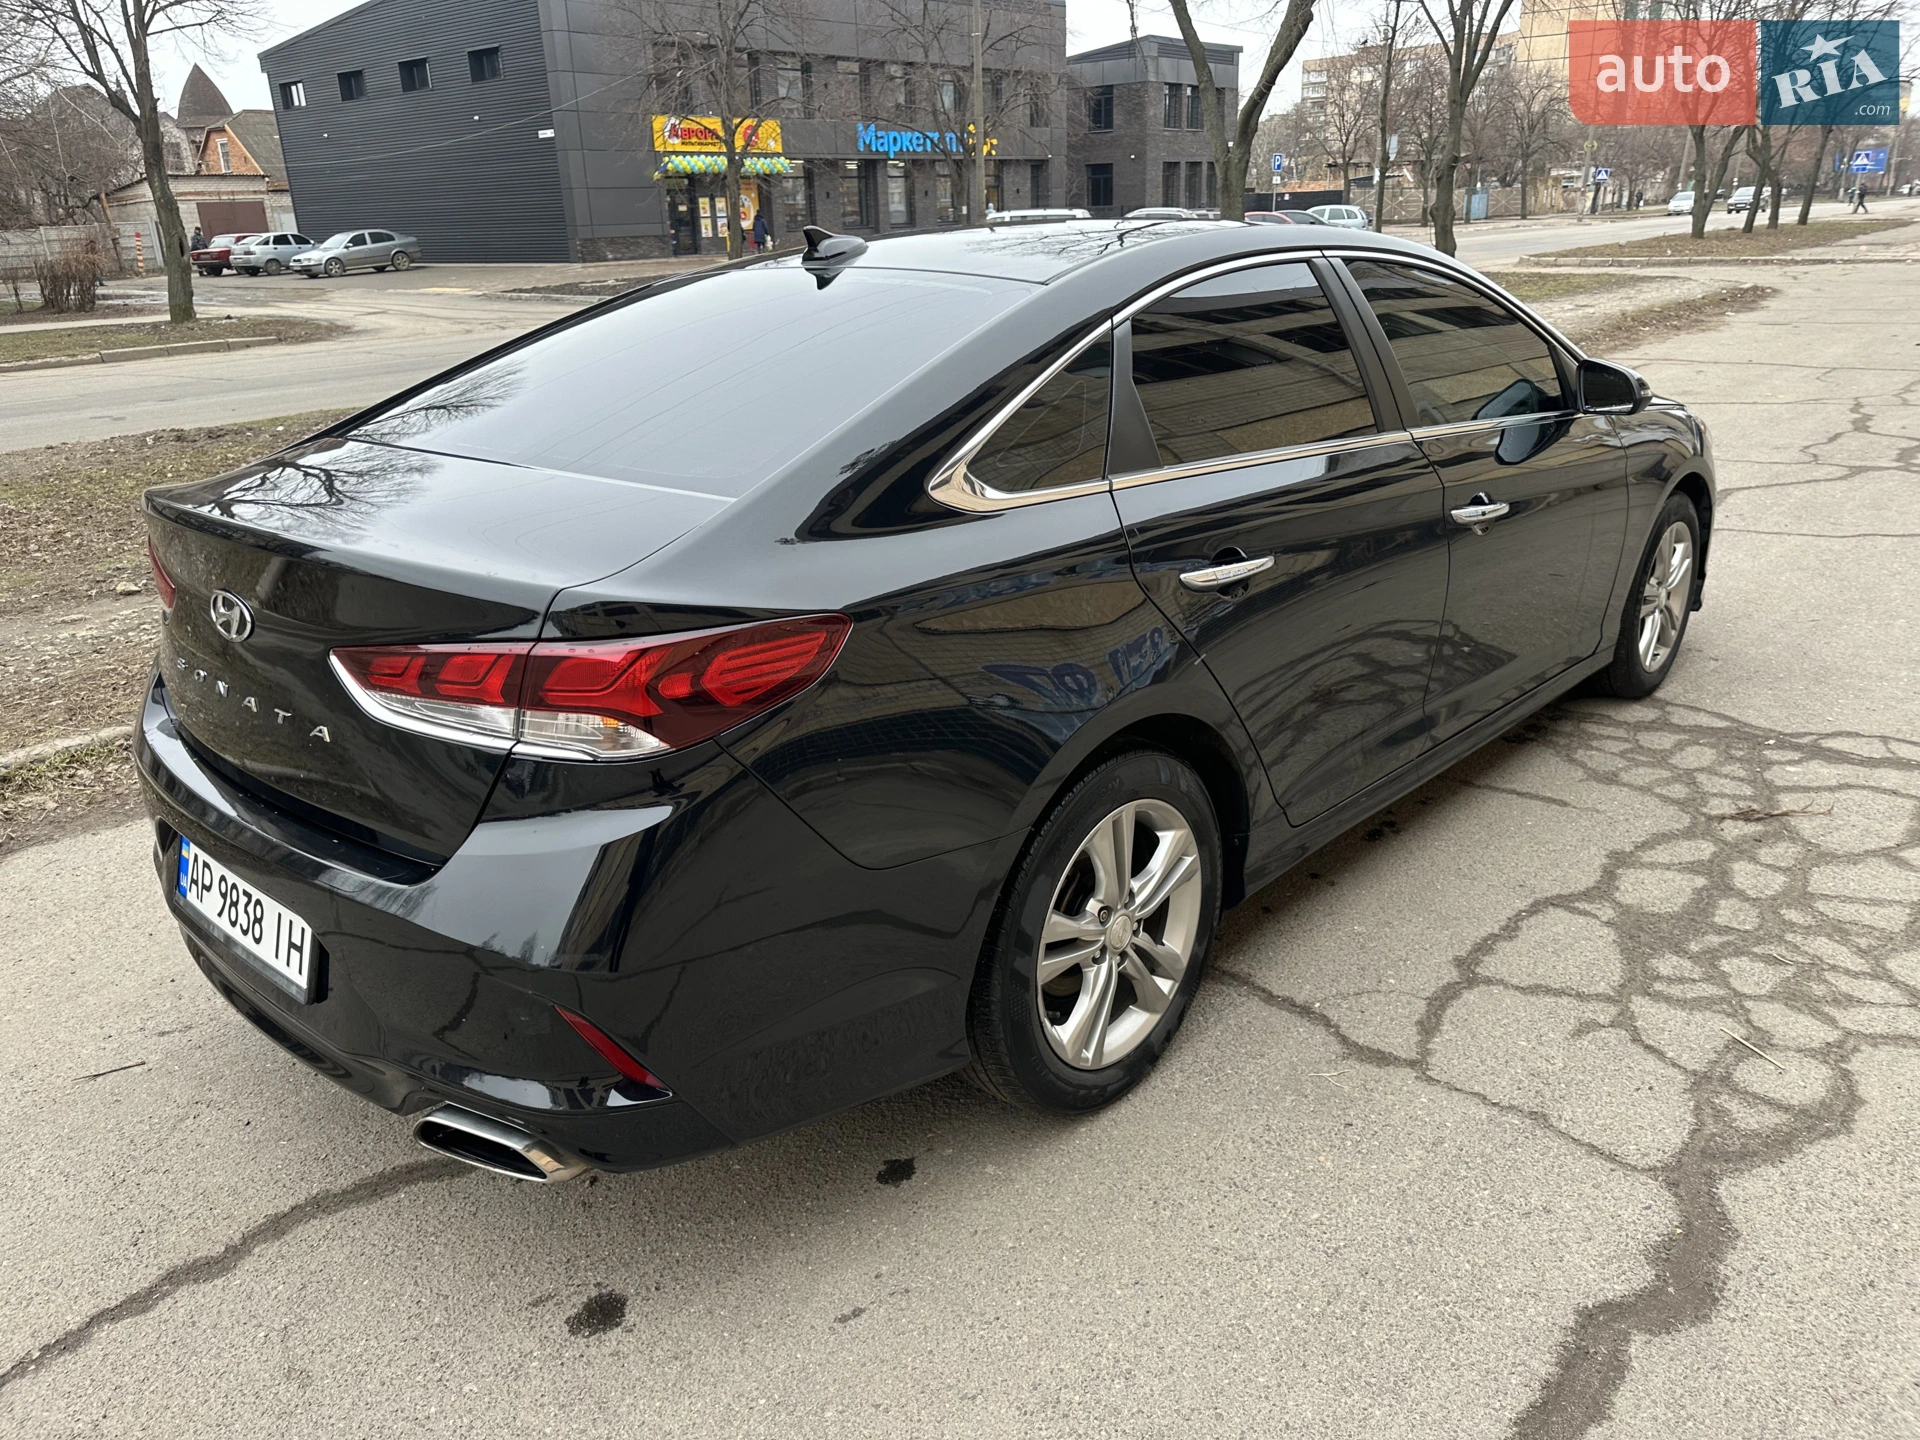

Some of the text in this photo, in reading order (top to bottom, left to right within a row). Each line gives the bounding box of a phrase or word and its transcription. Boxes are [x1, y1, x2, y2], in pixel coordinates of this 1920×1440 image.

[177, 658, 331, 743] SONATA
[180, 872, 187, 889] UA
[189, 852, 305, 976] AP 9838 IH
